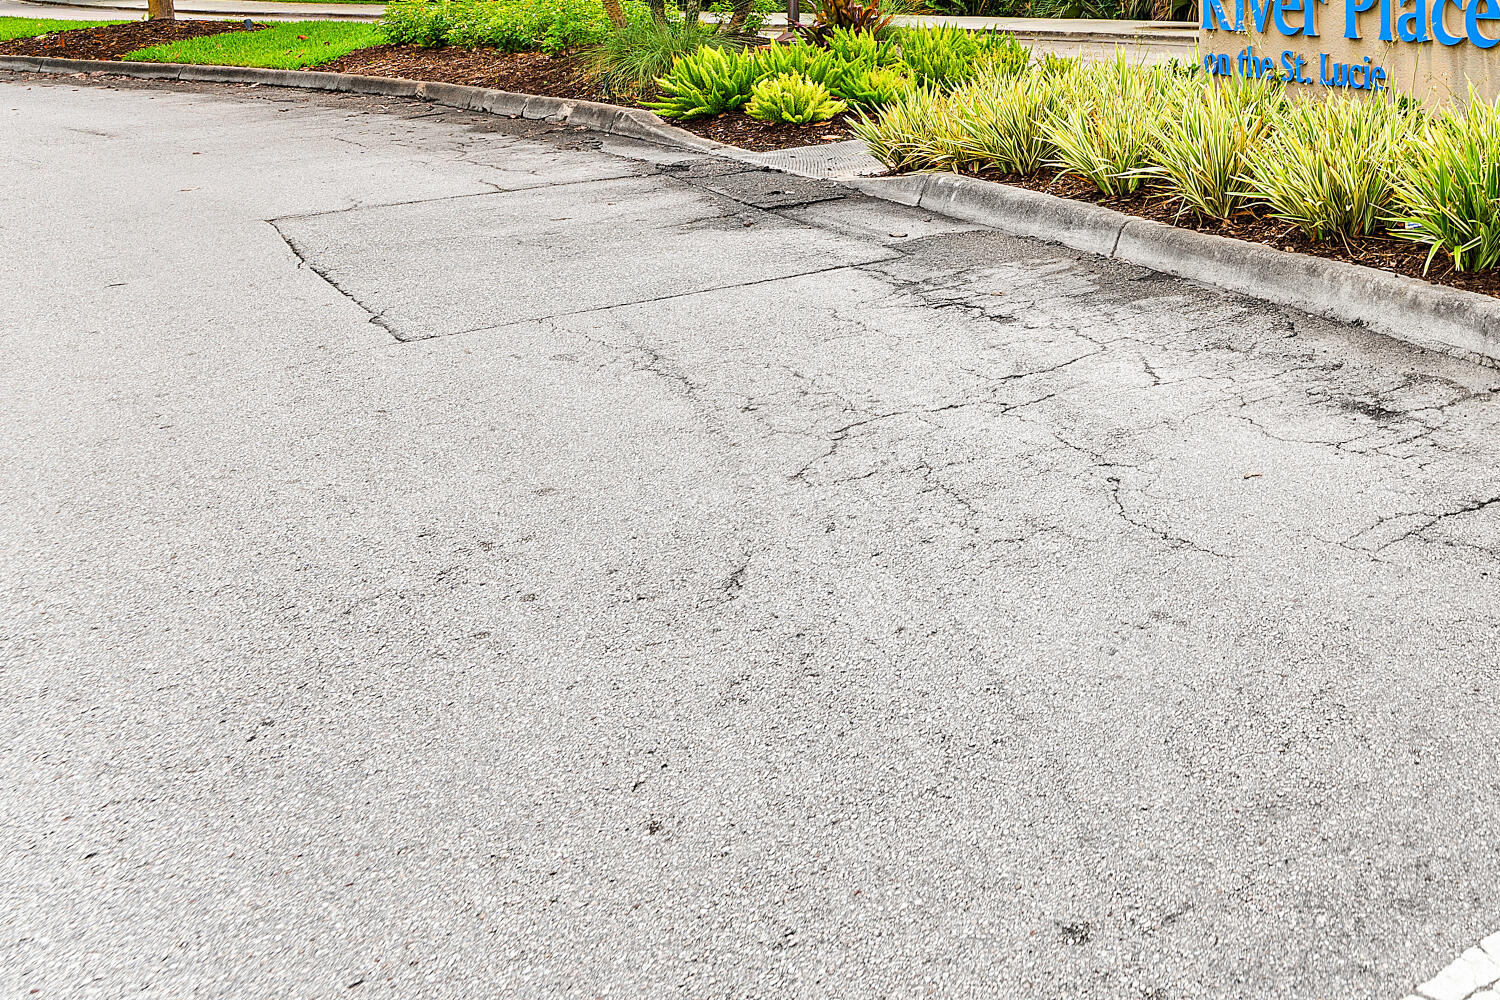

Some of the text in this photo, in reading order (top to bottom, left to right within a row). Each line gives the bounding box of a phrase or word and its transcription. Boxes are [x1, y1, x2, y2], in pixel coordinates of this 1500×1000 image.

[1204, 45, 1387, 92] on the St. Lucie
